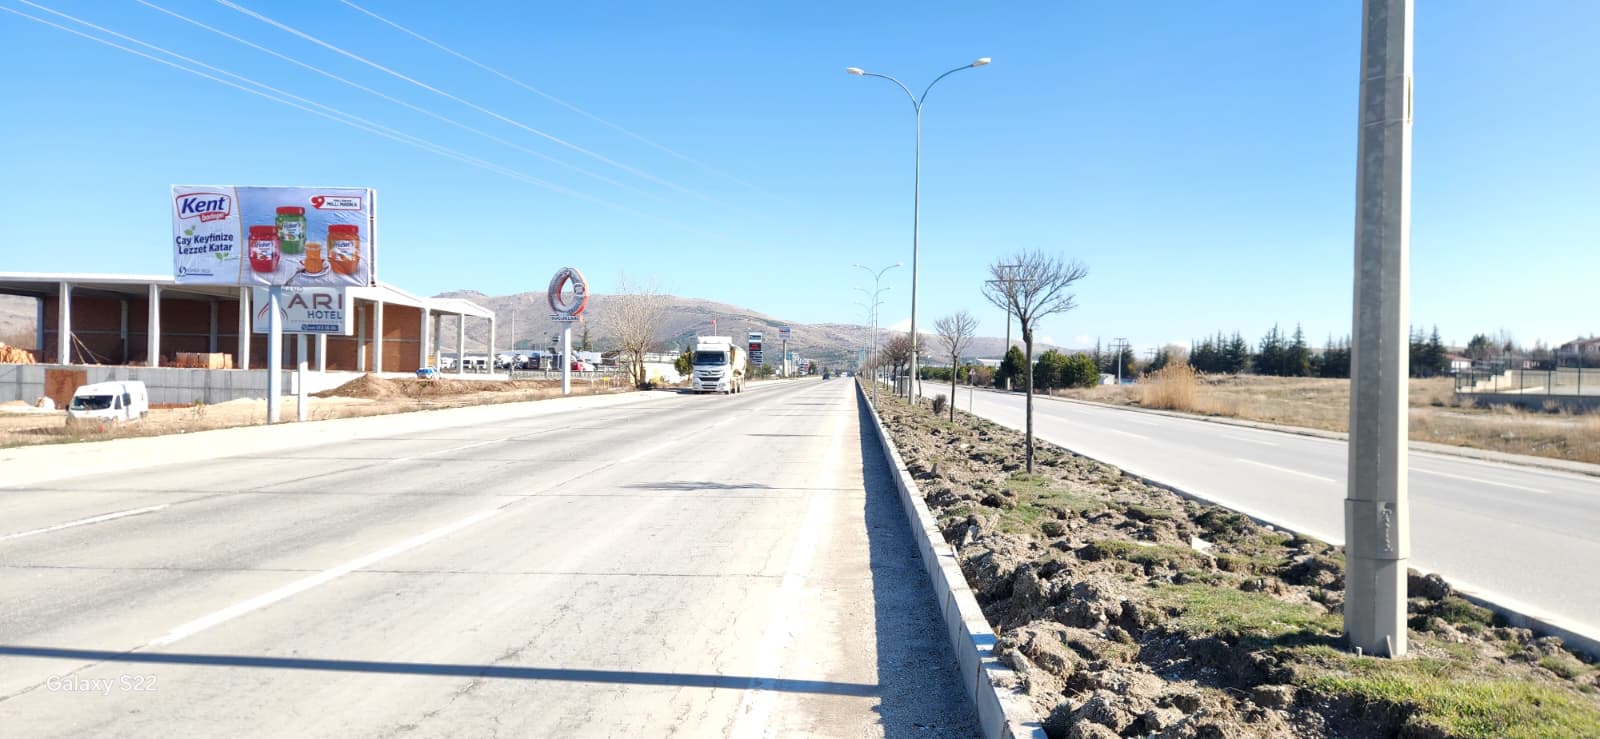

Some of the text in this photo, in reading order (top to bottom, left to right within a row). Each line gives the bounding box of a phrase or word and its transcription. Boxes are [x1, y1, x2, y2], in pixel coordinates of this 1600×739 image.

[181, 197, 226, 214] Kent
[194, 233, 234, 245] Keyfinize
[179, 243, 233, 255] Lezzet Katar
[287, 293, 342, 310] ARI
[307, 310, 343, 319] HOTEL
